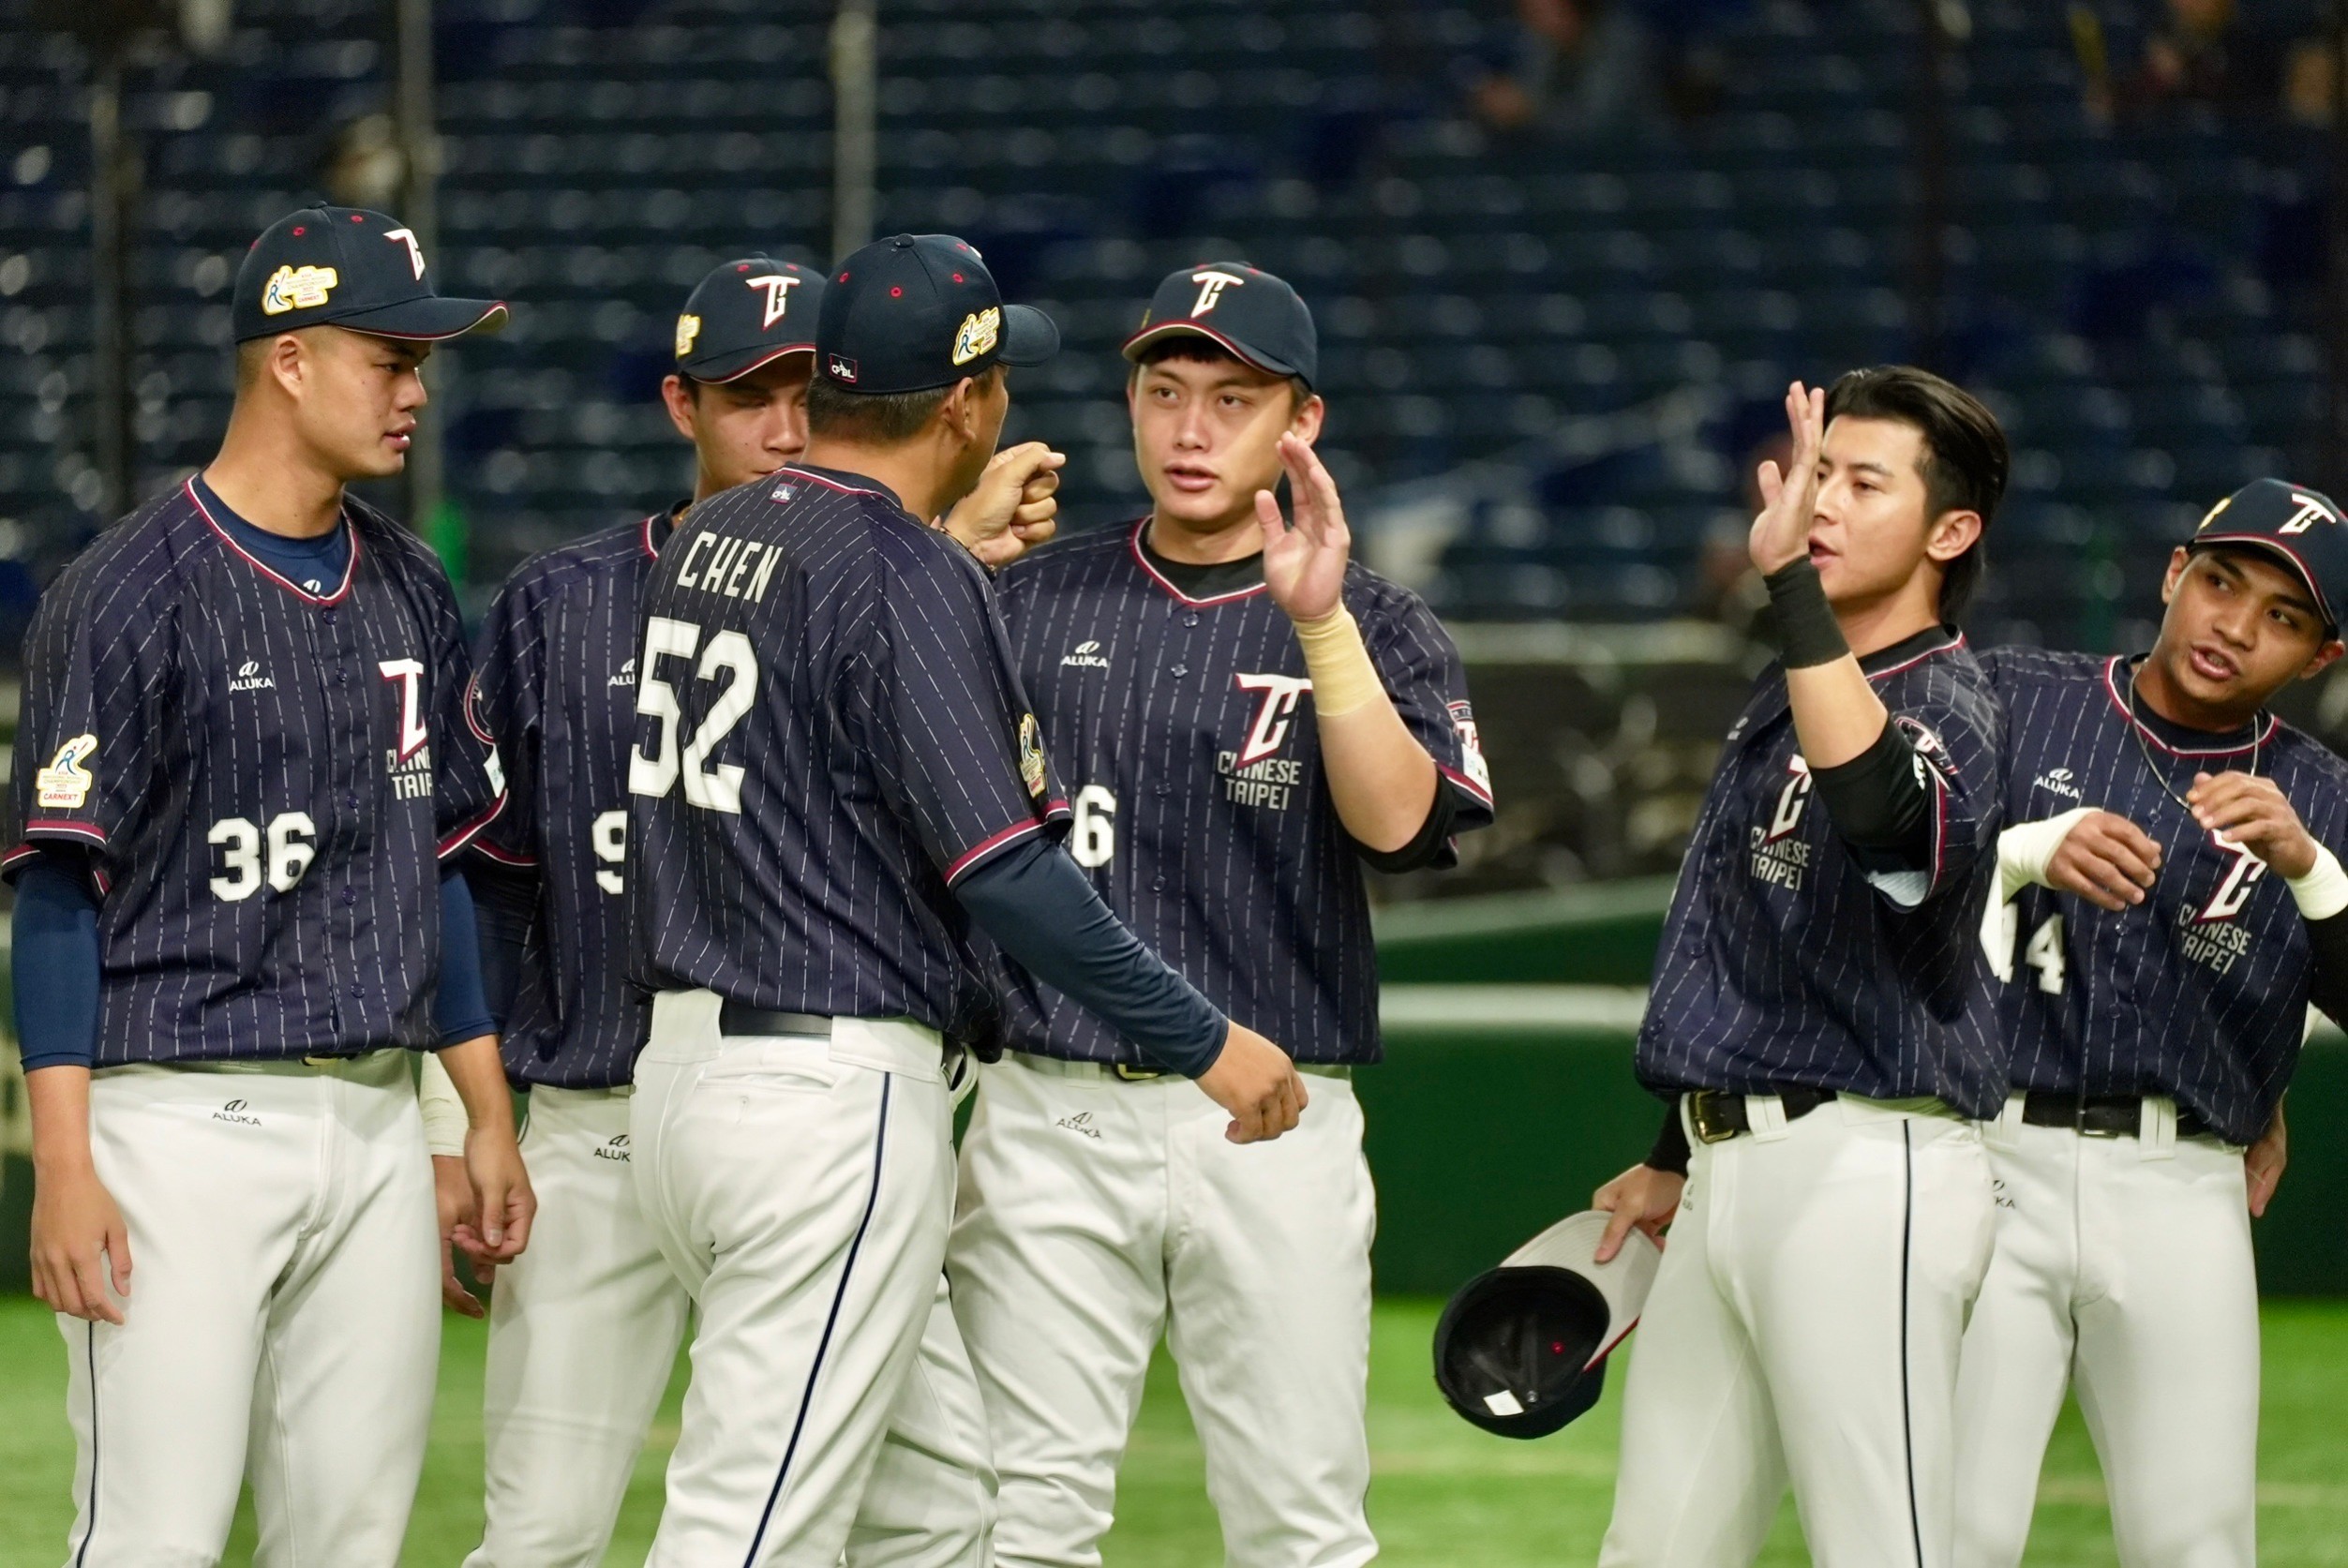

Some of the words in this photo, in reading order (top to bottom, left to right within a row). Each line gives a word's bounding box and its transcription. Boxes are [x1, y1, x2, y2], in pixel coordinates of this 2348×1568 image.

[677, 530, 783, 604] CHEN
[1060, 655, 1108, 667] ALUKA
[230, 677, 274, 692] ALUKA
[607, 674, 636, 686] ALU
[628, 616, 758, 814] 52
[43, 793, 79, 801] CARNEXT
[1225, 778, 1291, 811] TAIPEI
[2034, 775, 2080, 799] ALUKA
[1061, 784, 1117, 868] 6
[208, 812, 316, 902] 36
[1751, 853, 1802, 891] TAIPEI
[212, 1113, 262, 1127] ALUKA
[1055, 1118, 1101, 1140] ALUKA
[593, 1147, 631, 1162] ALUK
